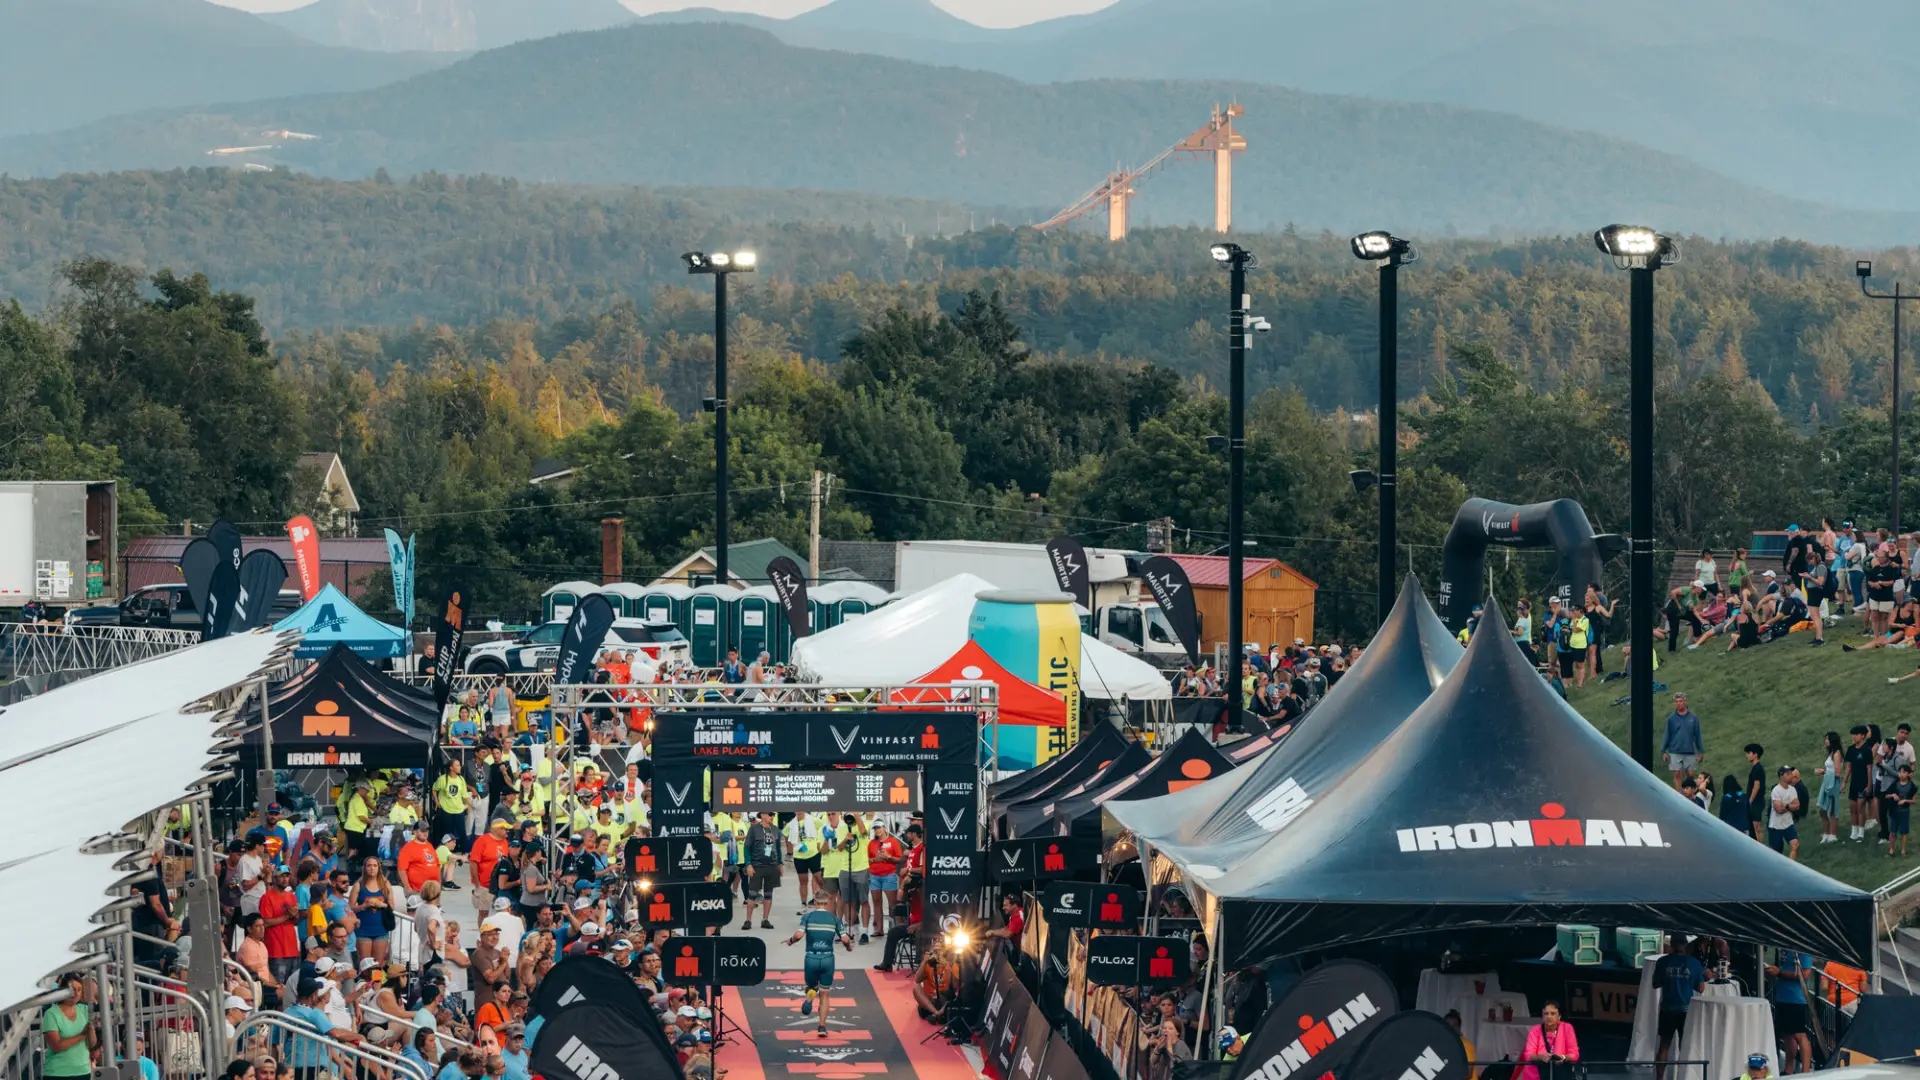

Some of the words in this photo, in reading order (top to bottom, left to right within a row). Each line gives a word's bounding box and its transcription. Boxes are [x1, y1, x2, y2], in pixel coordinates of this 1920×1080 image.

[297, 549, 312, 592] MEDICAL
[1052, 548, 1071, 588] MAURTEN
[772, 571, 793, 611] MAURTEN
[1146, 571, 1174, 611] MAURTEN
[1440, 582, 1452, 594] IKE
[1558, 585, 1571, 597] IKE
[1440, 594, 1450, 606] UT
[436, 645, 449, 677] CHIP
[694, 727, 772, 744] IRONMAN
[861, 736, 916, 744] VINFAST
[287, 748, 362, 766] IRONMAN
[694, 747, 719, 755] LAKE
[722, 747, 758, 755] PLACID
[944, 782, 974, 790] ATHLETIC
[1397, 807, 1668, 852] IRONMAN
[931, 856, 971, 869] HOKA
[691, 899, 726, 911] HOKA
[1091, 956, 1135, 965] FULGAZ
[1600, 991, 1637, 1014] VIP
[1243, 992, 1378, 1080] RONMAN
